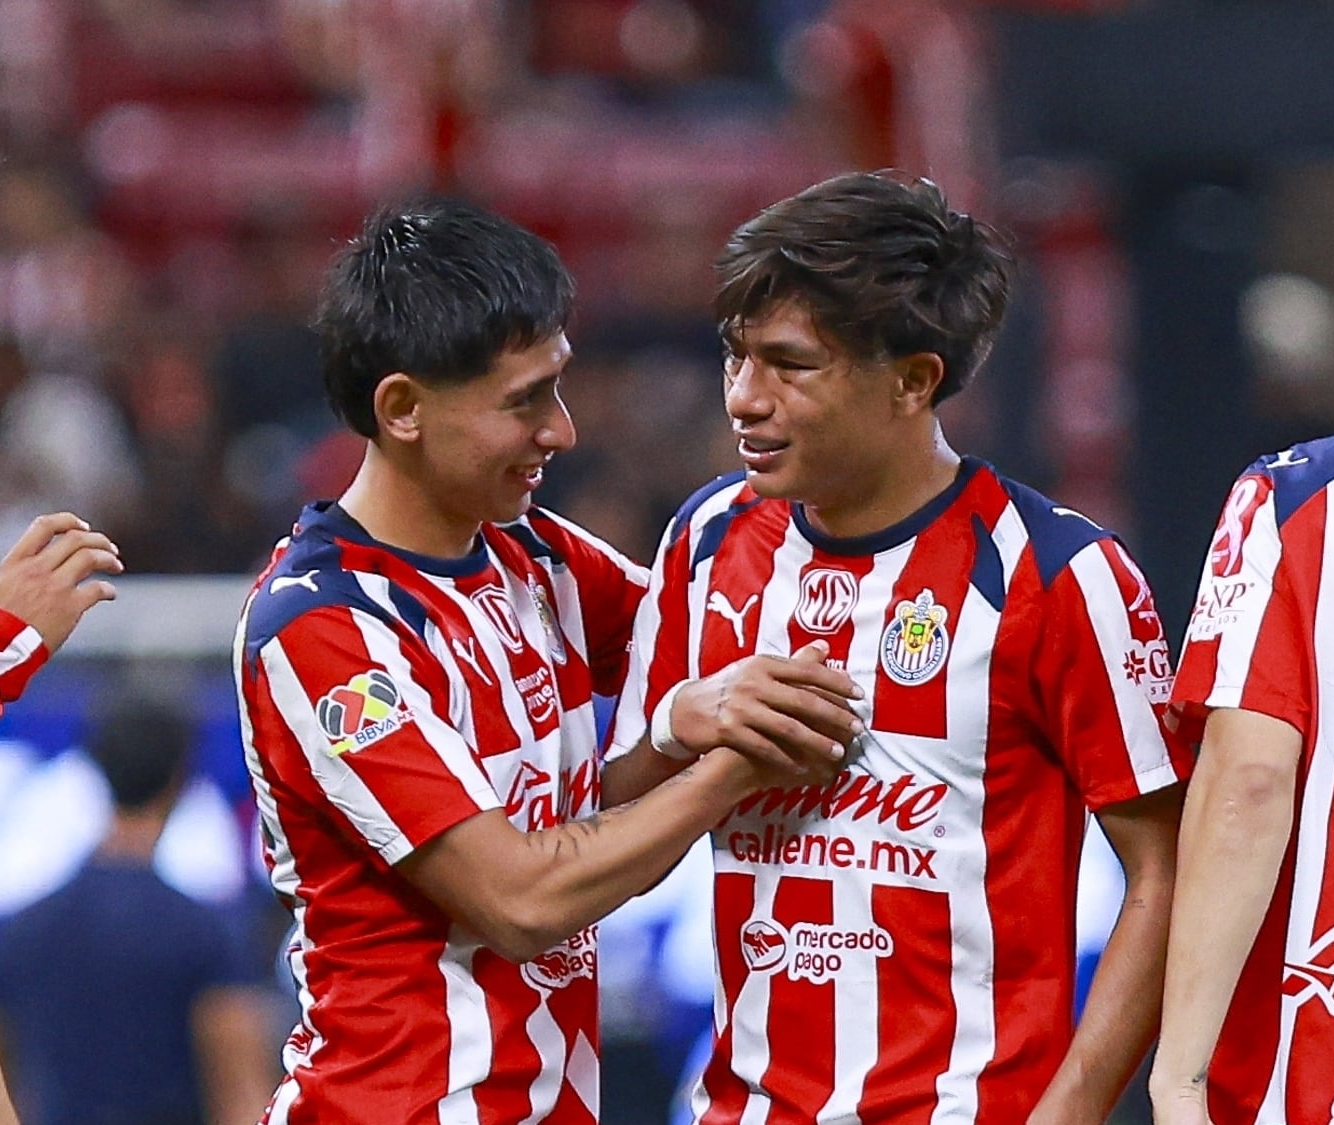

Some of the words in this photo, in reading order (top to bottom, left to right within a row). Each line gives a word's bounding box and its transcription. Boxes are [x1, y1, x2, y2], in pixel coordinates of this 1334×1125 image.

[355, 718, 396, 744] BBVA
[728, 824, 938, 880] caliene.mx
[796, 928, 889, 951] mercado
[794, 951, 842, 977] pago
